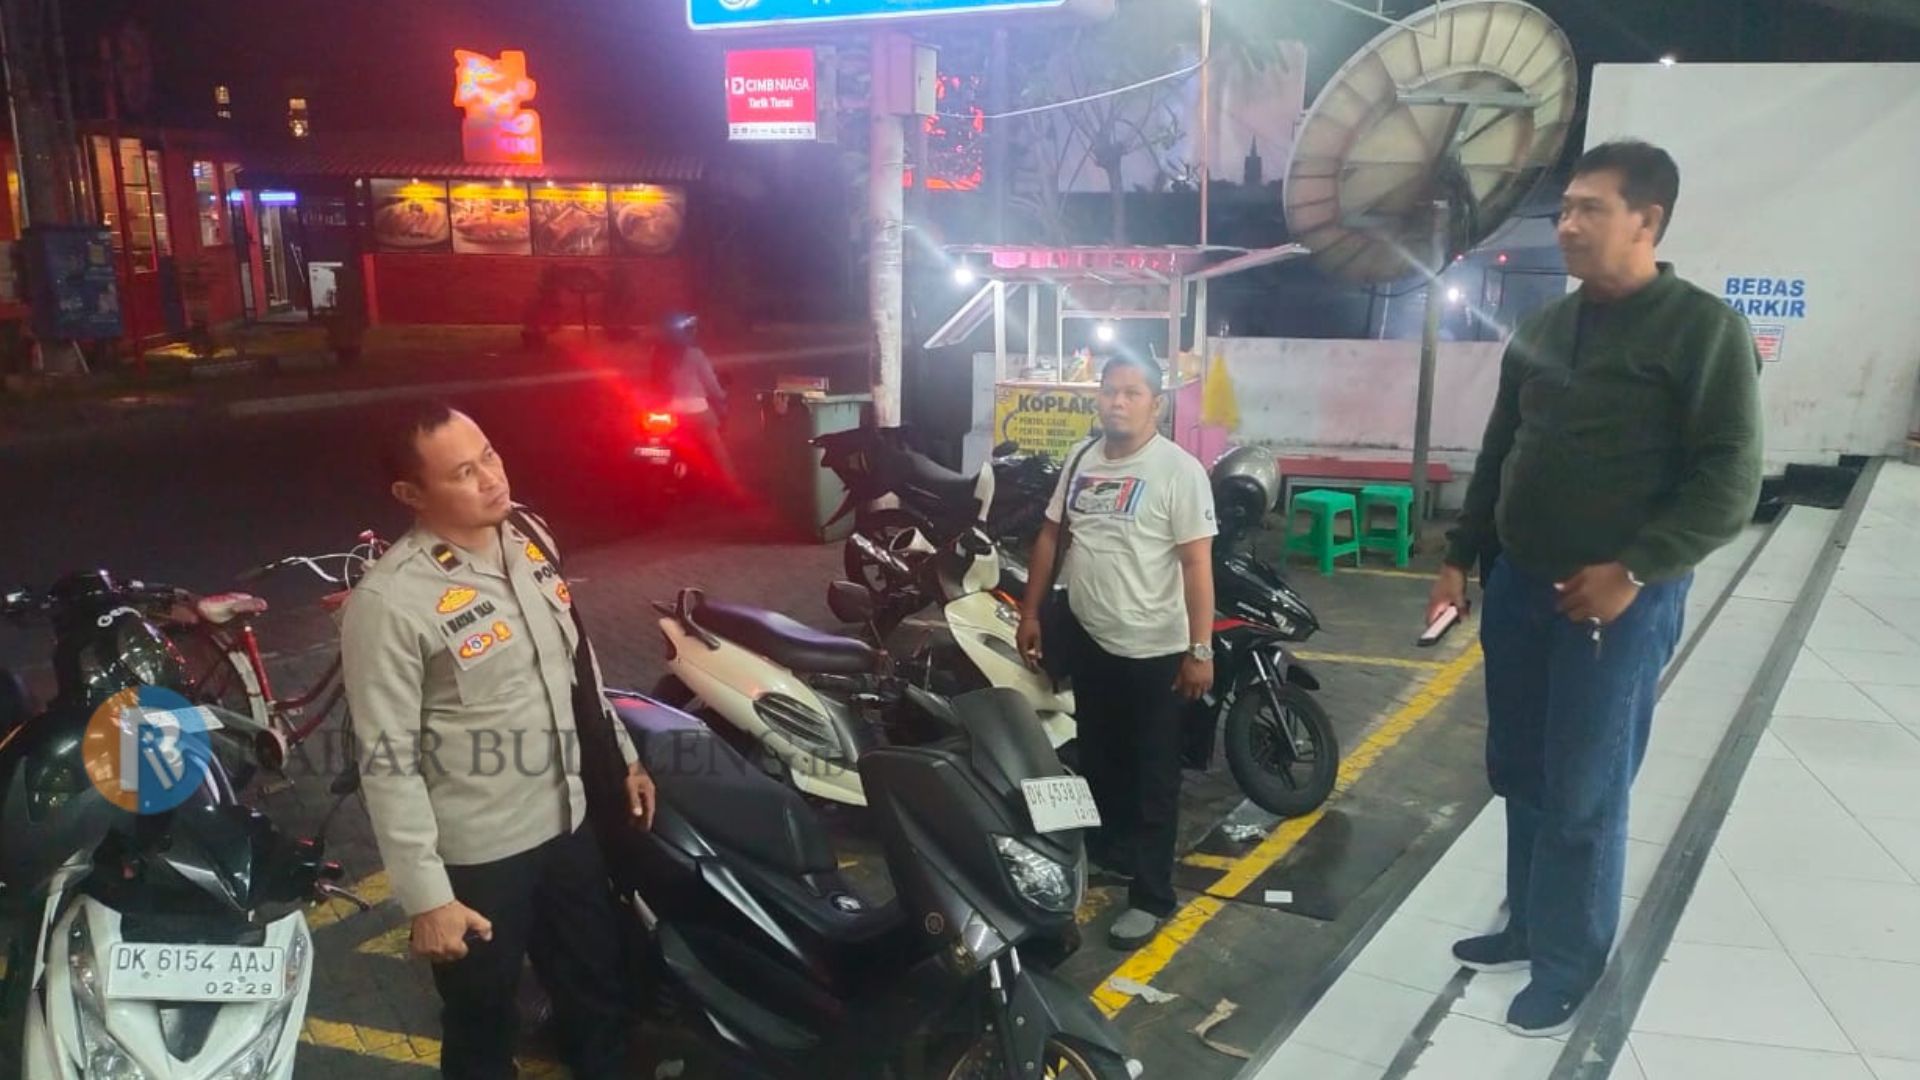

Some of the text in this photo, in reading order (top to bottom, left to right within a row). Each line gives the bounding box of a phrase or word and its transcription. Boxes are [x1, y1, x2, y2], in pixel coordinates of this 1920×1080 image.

[1725, 277, 1805, 297] BEBAS
[117, 947, 275, 973] DK 6154 AAJ
